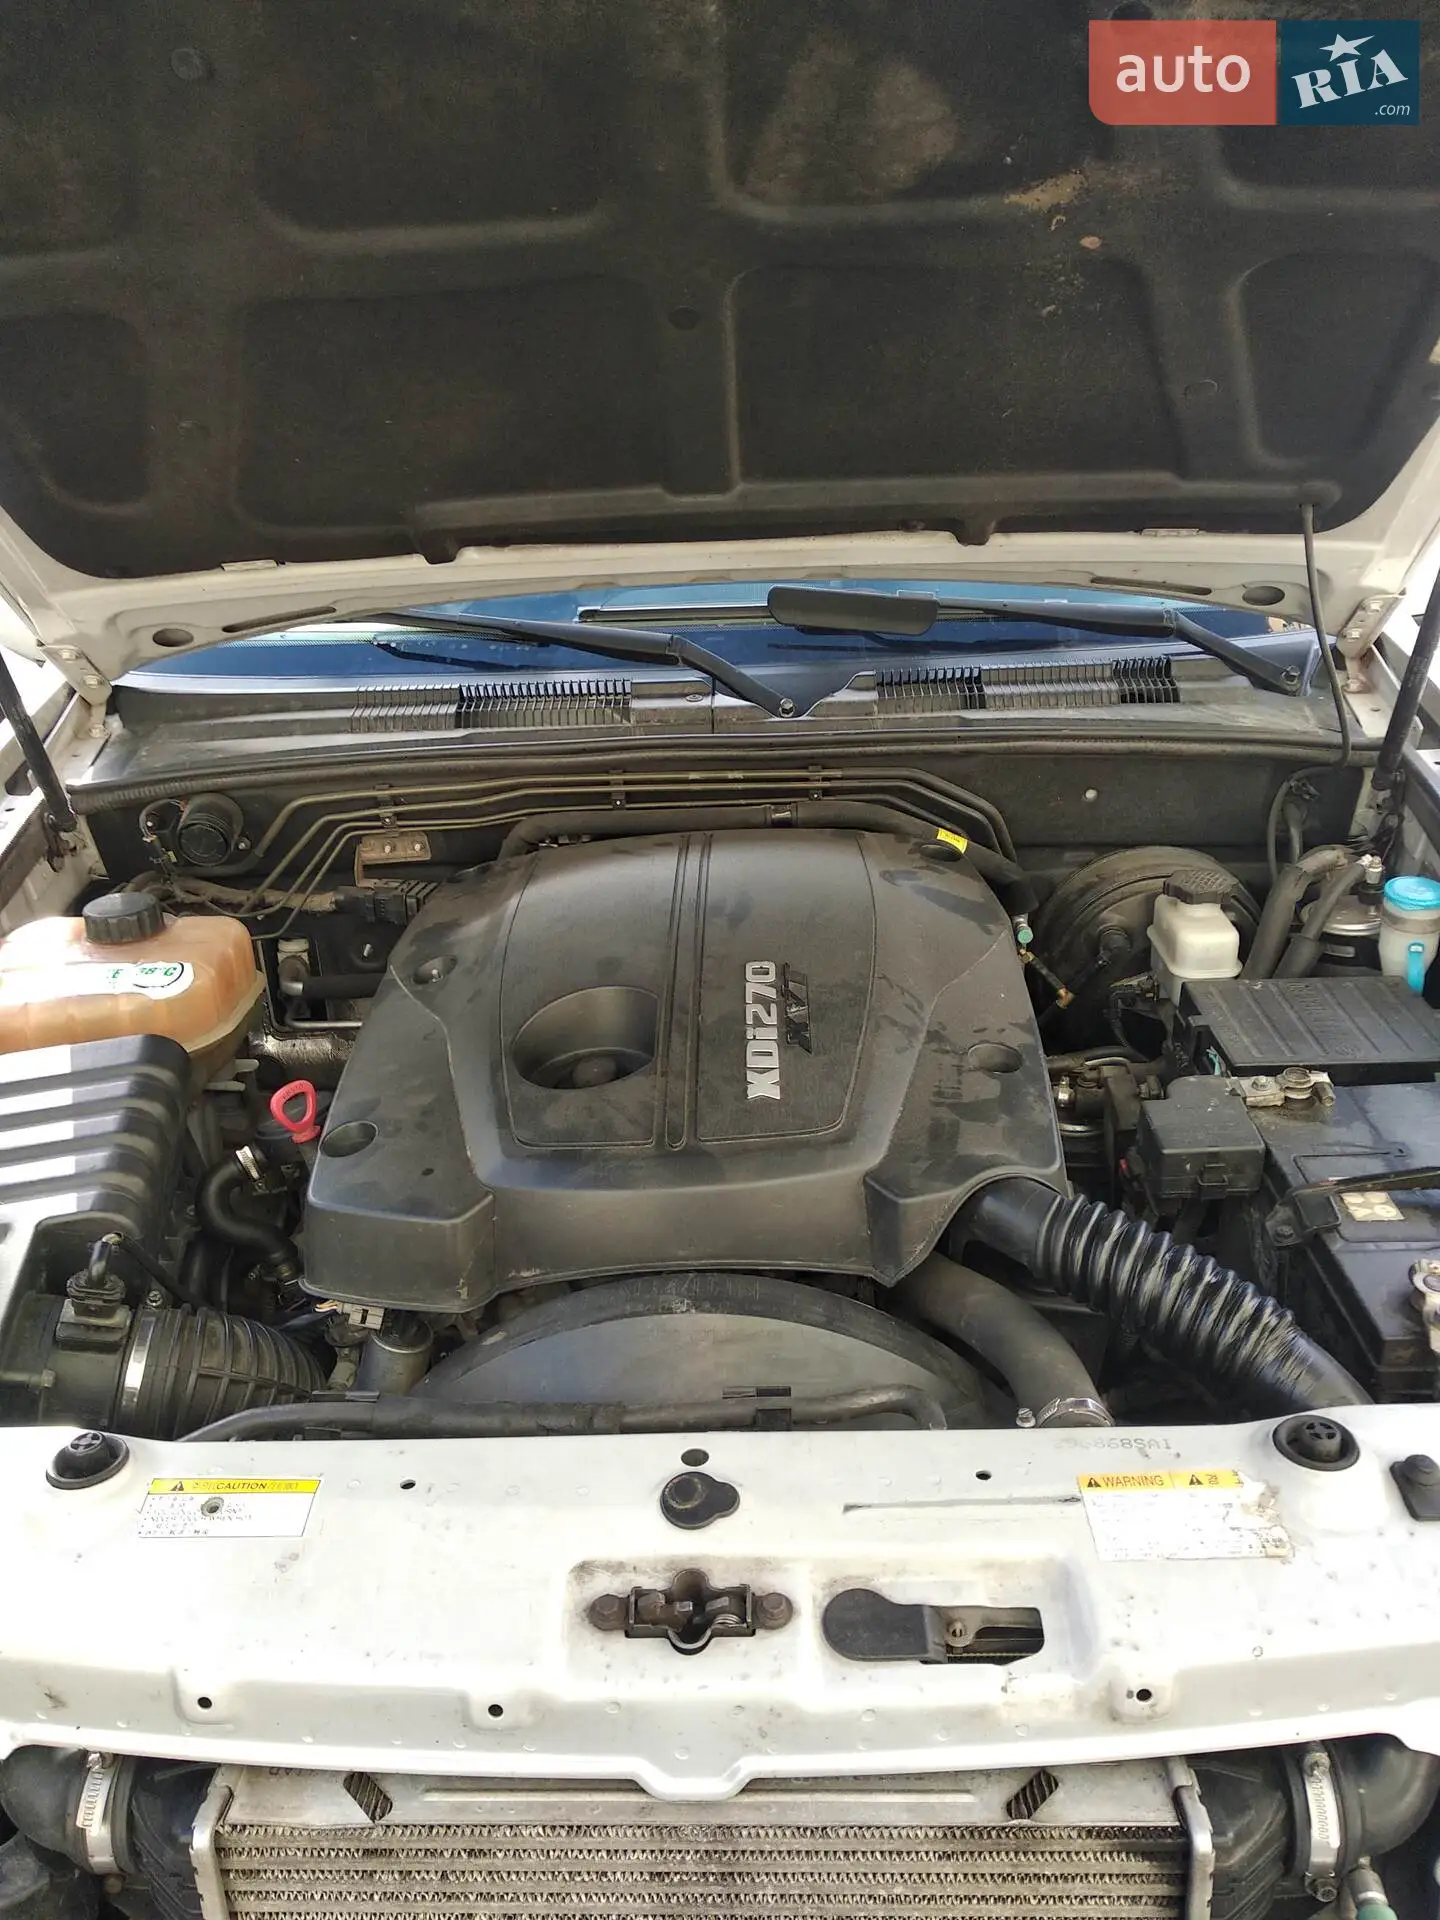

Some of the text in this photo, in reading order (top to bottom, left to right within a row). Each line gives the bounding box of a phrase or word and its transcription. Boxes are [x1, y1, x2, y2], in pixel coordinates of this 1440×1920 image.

[745, 960, 781, 1100] XDi270
[217, 1482, 268, 1490] CAUTION
[1102, 1475, 1165, 1488] WARNING
